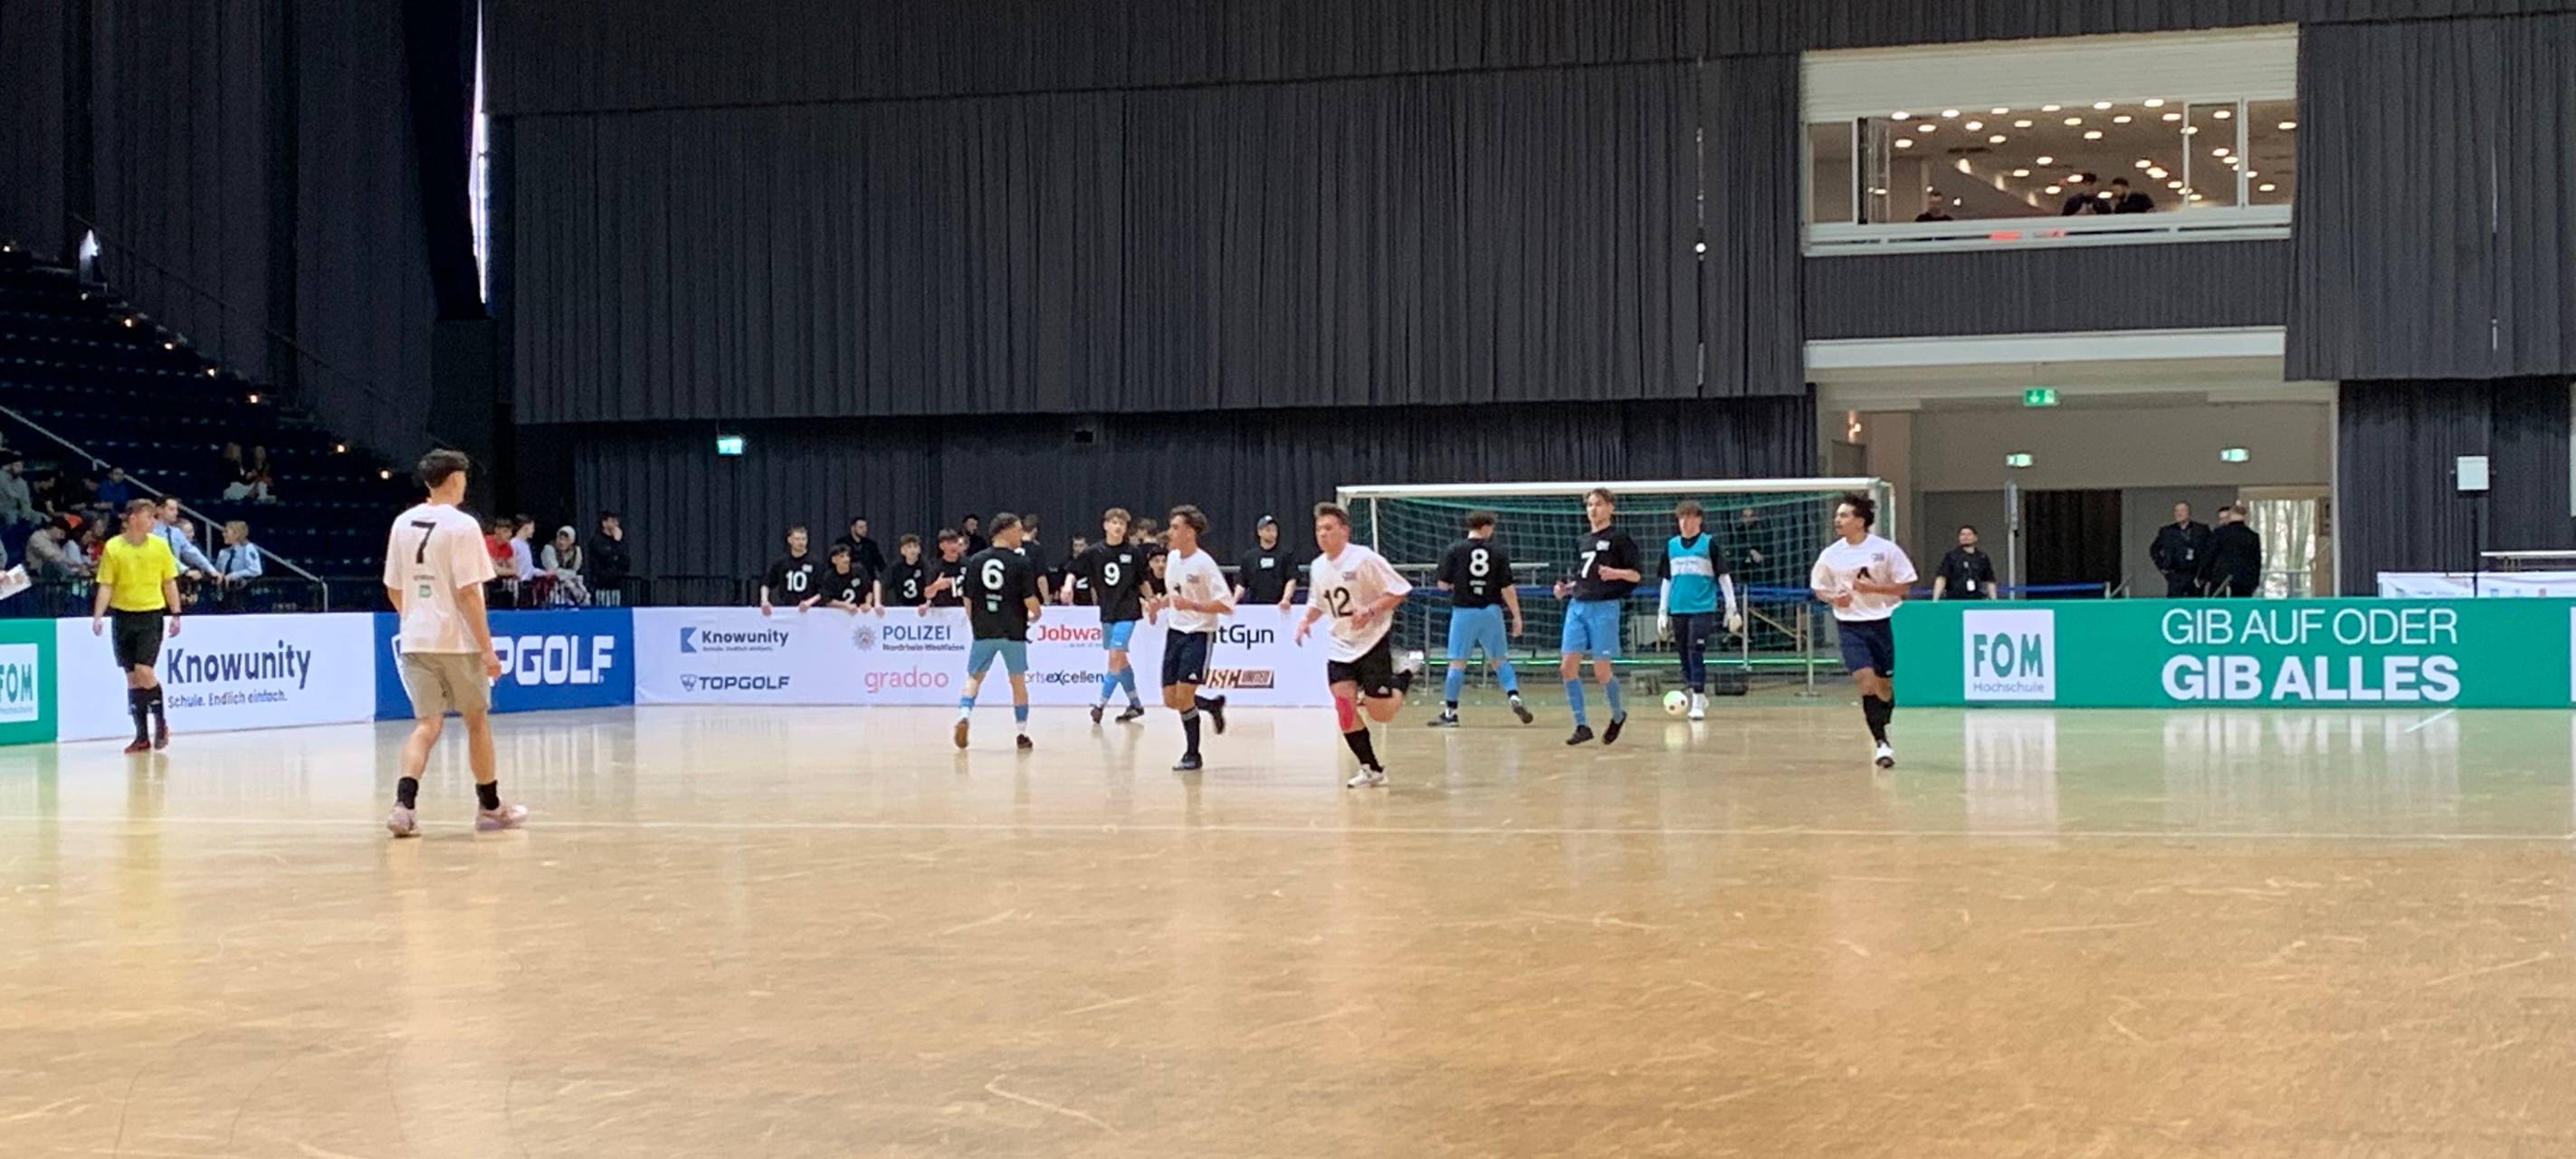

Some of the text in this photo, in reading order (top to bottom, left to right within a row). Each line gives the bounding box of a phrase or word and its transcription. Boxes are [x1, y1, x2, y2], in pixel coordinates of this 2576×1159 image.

[411, 521, 437, 564] 7
[981, 559, 1005, 589] 6
[1104, 562, 1120, 586] 9
[1469, 549, 1490, 577] 8
[1580, 551, 1597, 579] 7
[786, 570, 807, 592] 10
[903, 580, 917, 599] 3
[843, 589, 856, 604] 2
[1324, 587, 1354, 618] 12
[702, 628, 789, 647] Knowunity
[883, 626, 950, 640] POLIZEI
[1037, 624, 1102, 641] Jobwa
[2161, 608, 2457, 645] GIB AUF ODER
[167, 639, 311, 690] Knowunity
[490, 636, 615, 686] PGOLF
[1973, 633, 2045, 677] FOM
[700, 675, 790, 690] TOPGOLF
[864, 665, 949, 693] gradoo
[1973, 682, 2045, 693] Hochschule
[2161, 655, 2461, 702] GIB ALLES
[168, 694, 205, 709] Schule.
[209, 691, 245, 706] Endlich
